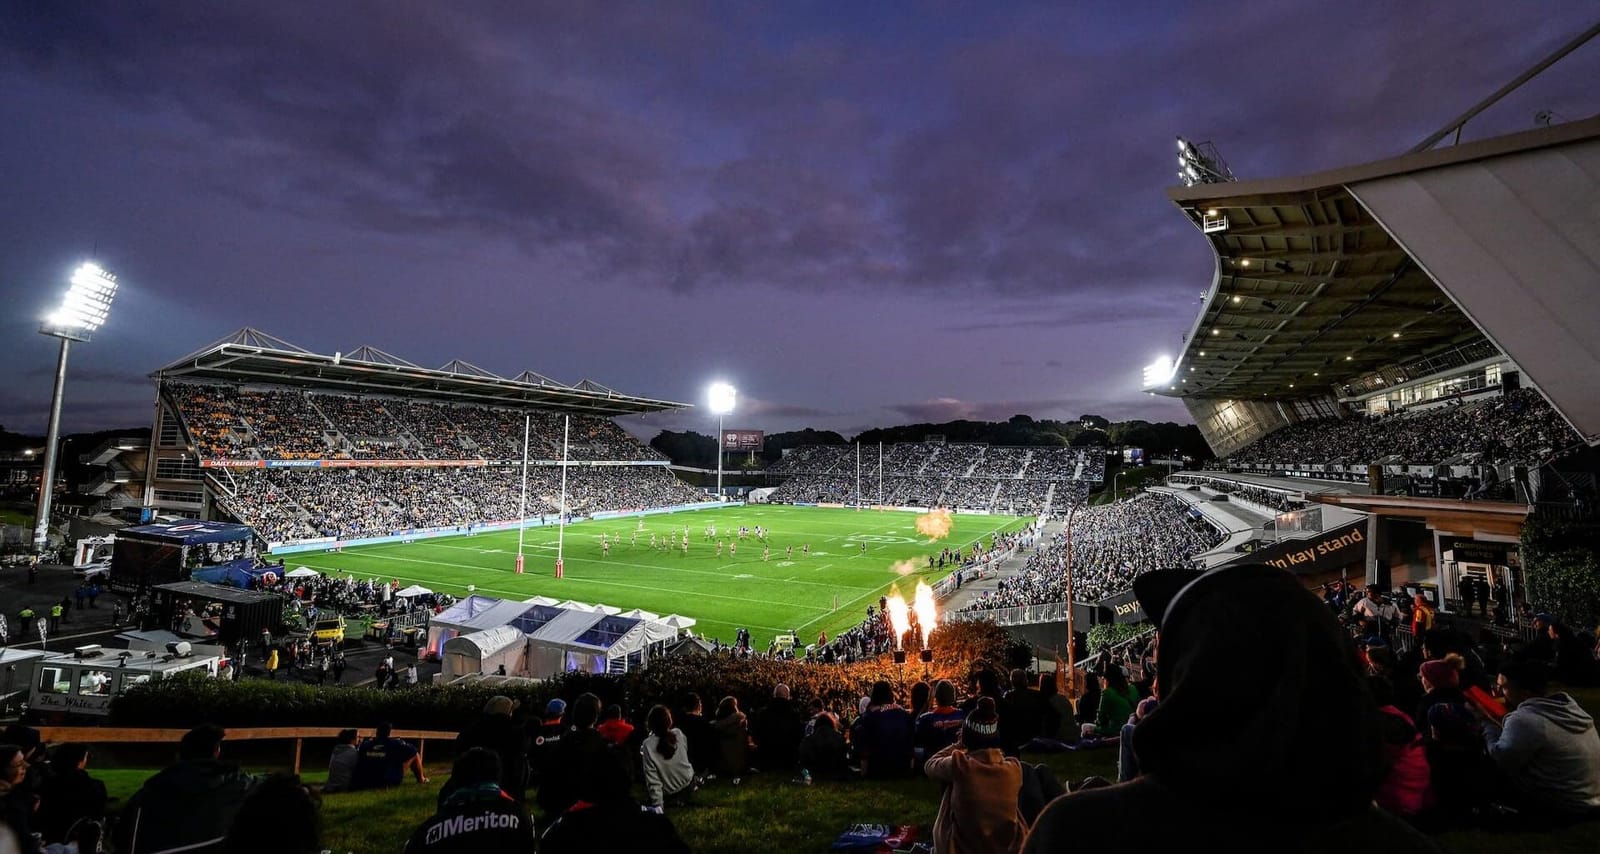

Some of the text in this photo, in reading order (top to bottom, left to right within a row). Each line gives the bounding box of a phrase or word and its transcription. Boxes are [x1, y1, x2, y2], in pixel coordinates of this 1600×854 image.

[1286, 547, 1316, 566] kay
[1316, 528, 1364, 555] stand
[40, 695, 59, 705] The
[65, 696, 95, 709] White
[443, 811, 519, 838] Meriton
